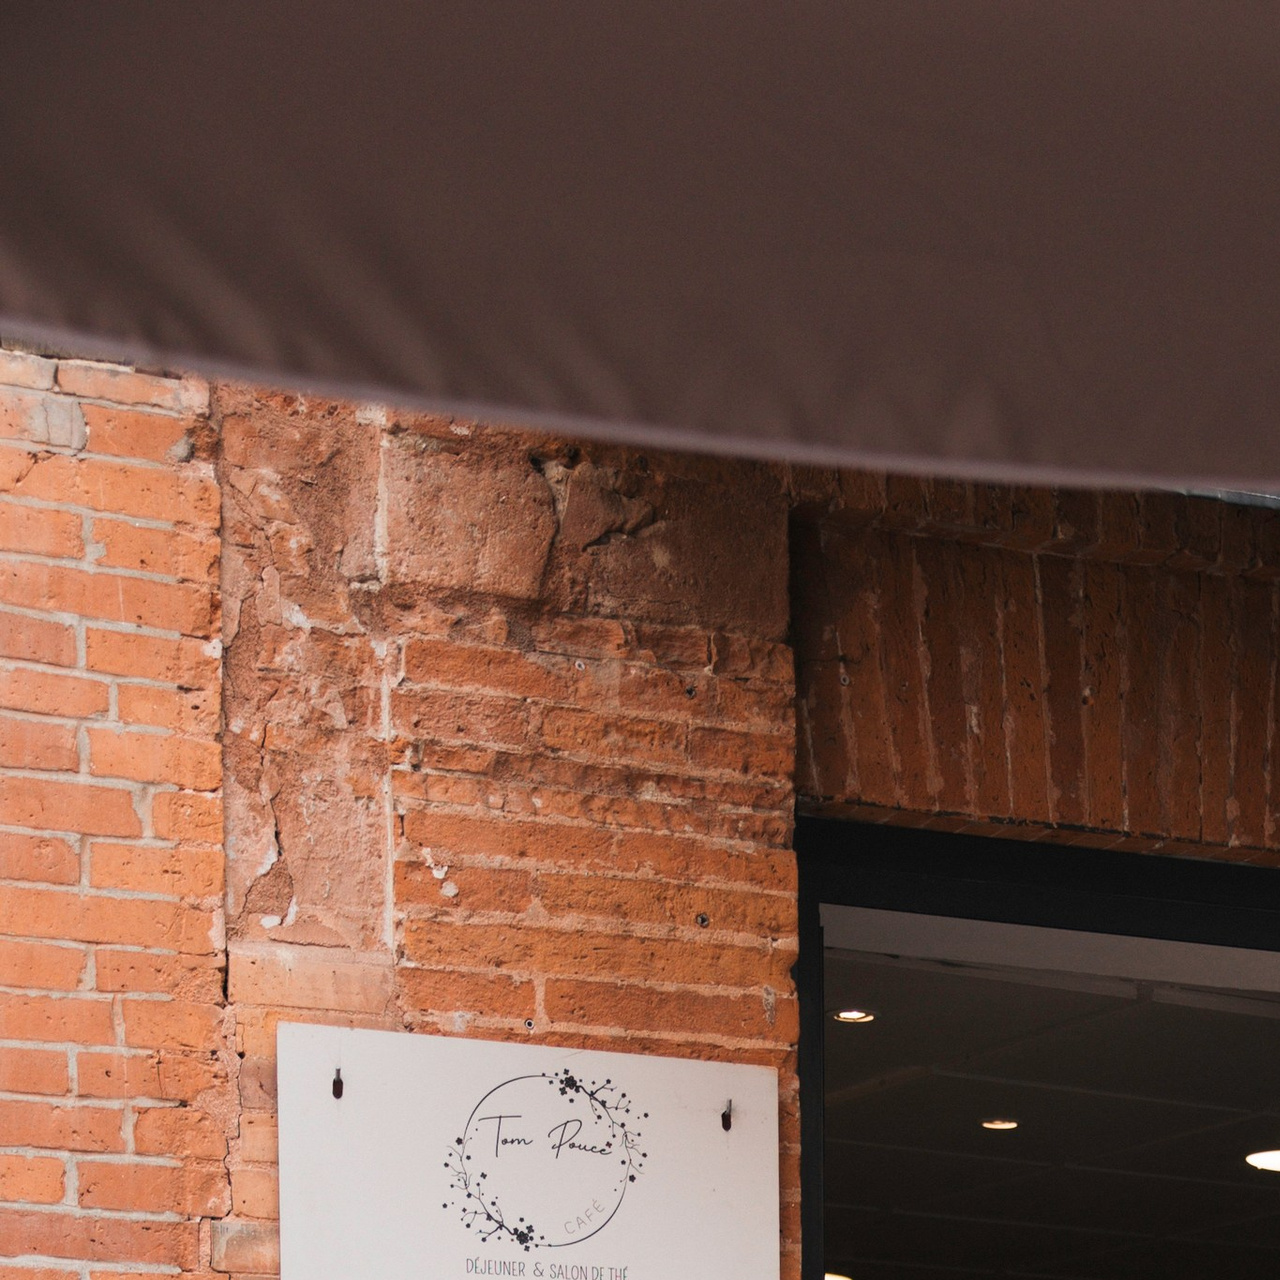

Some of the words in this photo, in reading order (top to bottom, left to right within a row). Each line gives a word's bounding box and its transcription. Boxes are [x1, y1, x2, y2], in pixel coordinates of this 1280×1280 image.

[477, 1115, 534, 1158] Tom
[547, 1119, 612, 1159] Pouce
[563, 1198, 606, 1235] CAFÉ
[466, 1256, 526, 1278] DÉJEUNER
[533, 1262, 544, 1278] &
